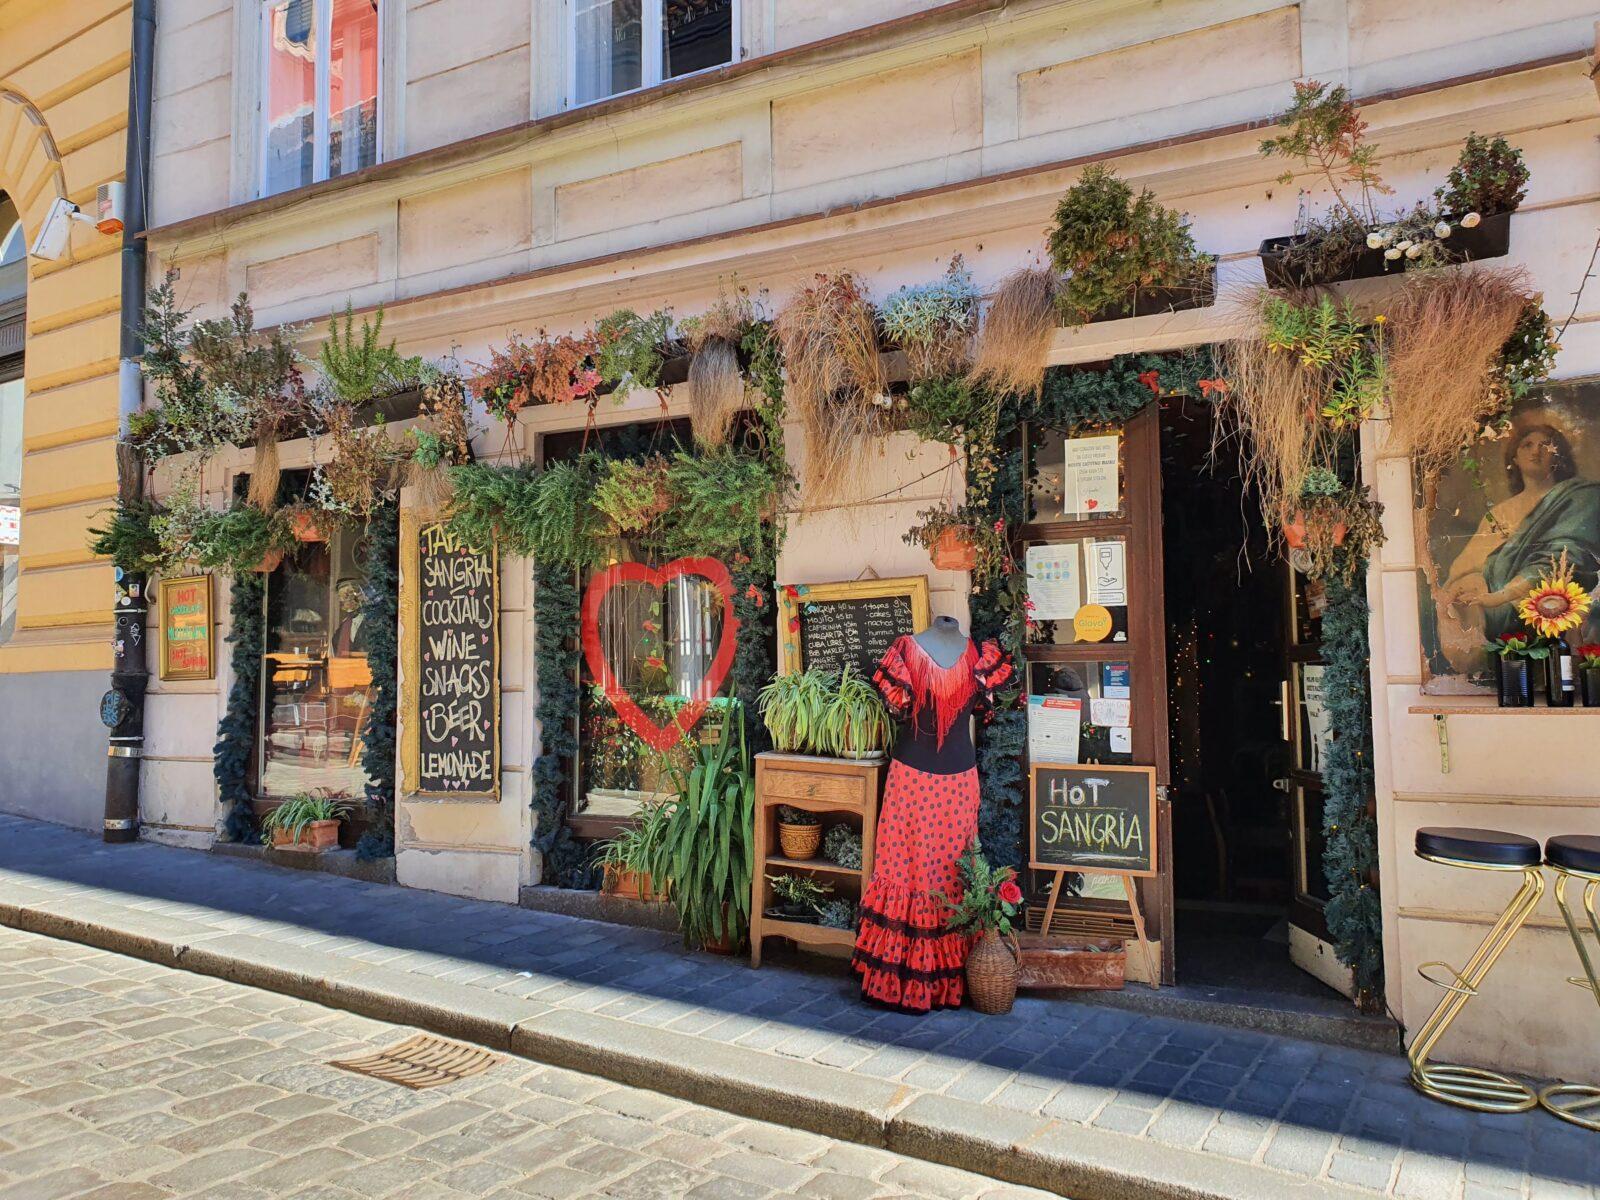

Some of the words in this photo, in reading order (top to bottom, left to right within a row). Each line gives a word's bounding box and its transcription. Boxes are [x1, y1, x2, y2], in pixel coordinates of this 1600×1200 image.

[177, 588, 197, 604] HOT
[423, 595, 493, 629] COCKTAILS
[807, 616, 834, 624] MOJITO
[867, 620, 894, 628] nachos
[422, 660, 490, 699] SNACKS
[425, 700, 486, 743] BEER
[421, 750, 492, 783] LEMONADE
